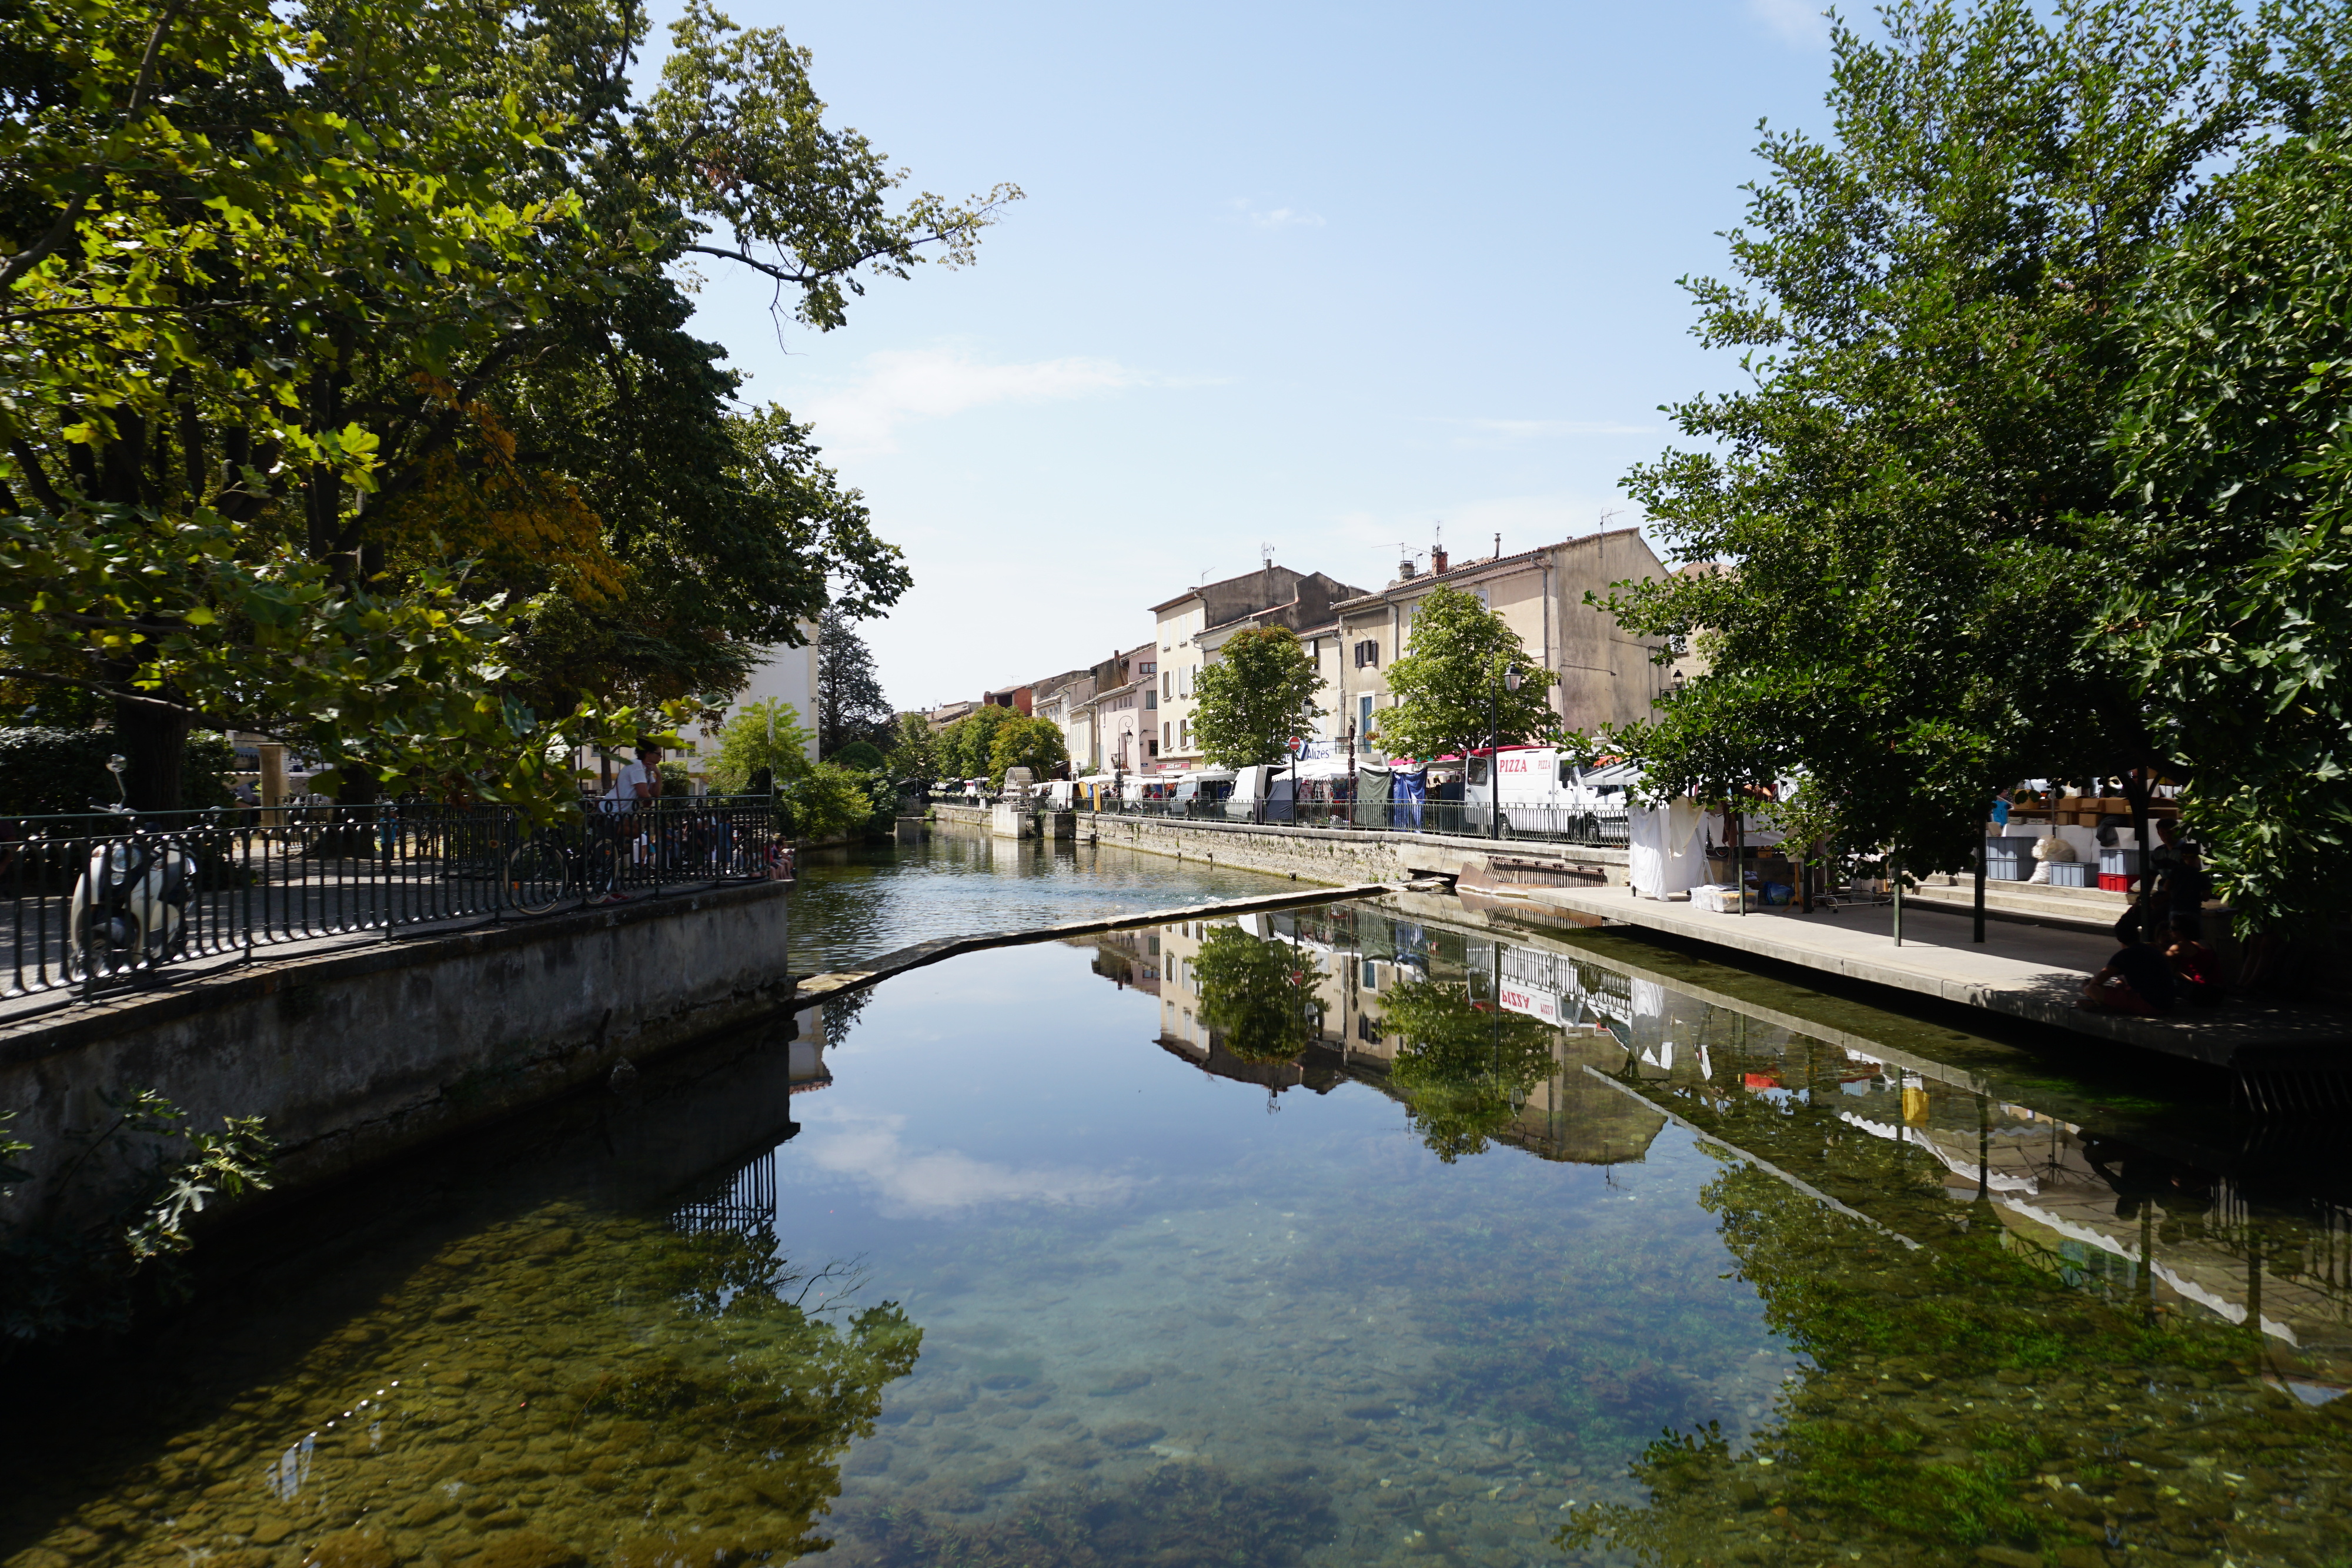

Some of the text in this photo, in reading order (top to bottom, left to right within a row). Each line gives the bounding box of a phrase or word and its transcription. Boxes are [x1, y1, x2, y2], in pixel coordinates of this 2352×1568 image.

[1307, 747, 1329, 760] Alizés
[1499, 759, 1551, 773] PIZZA PIZZA
